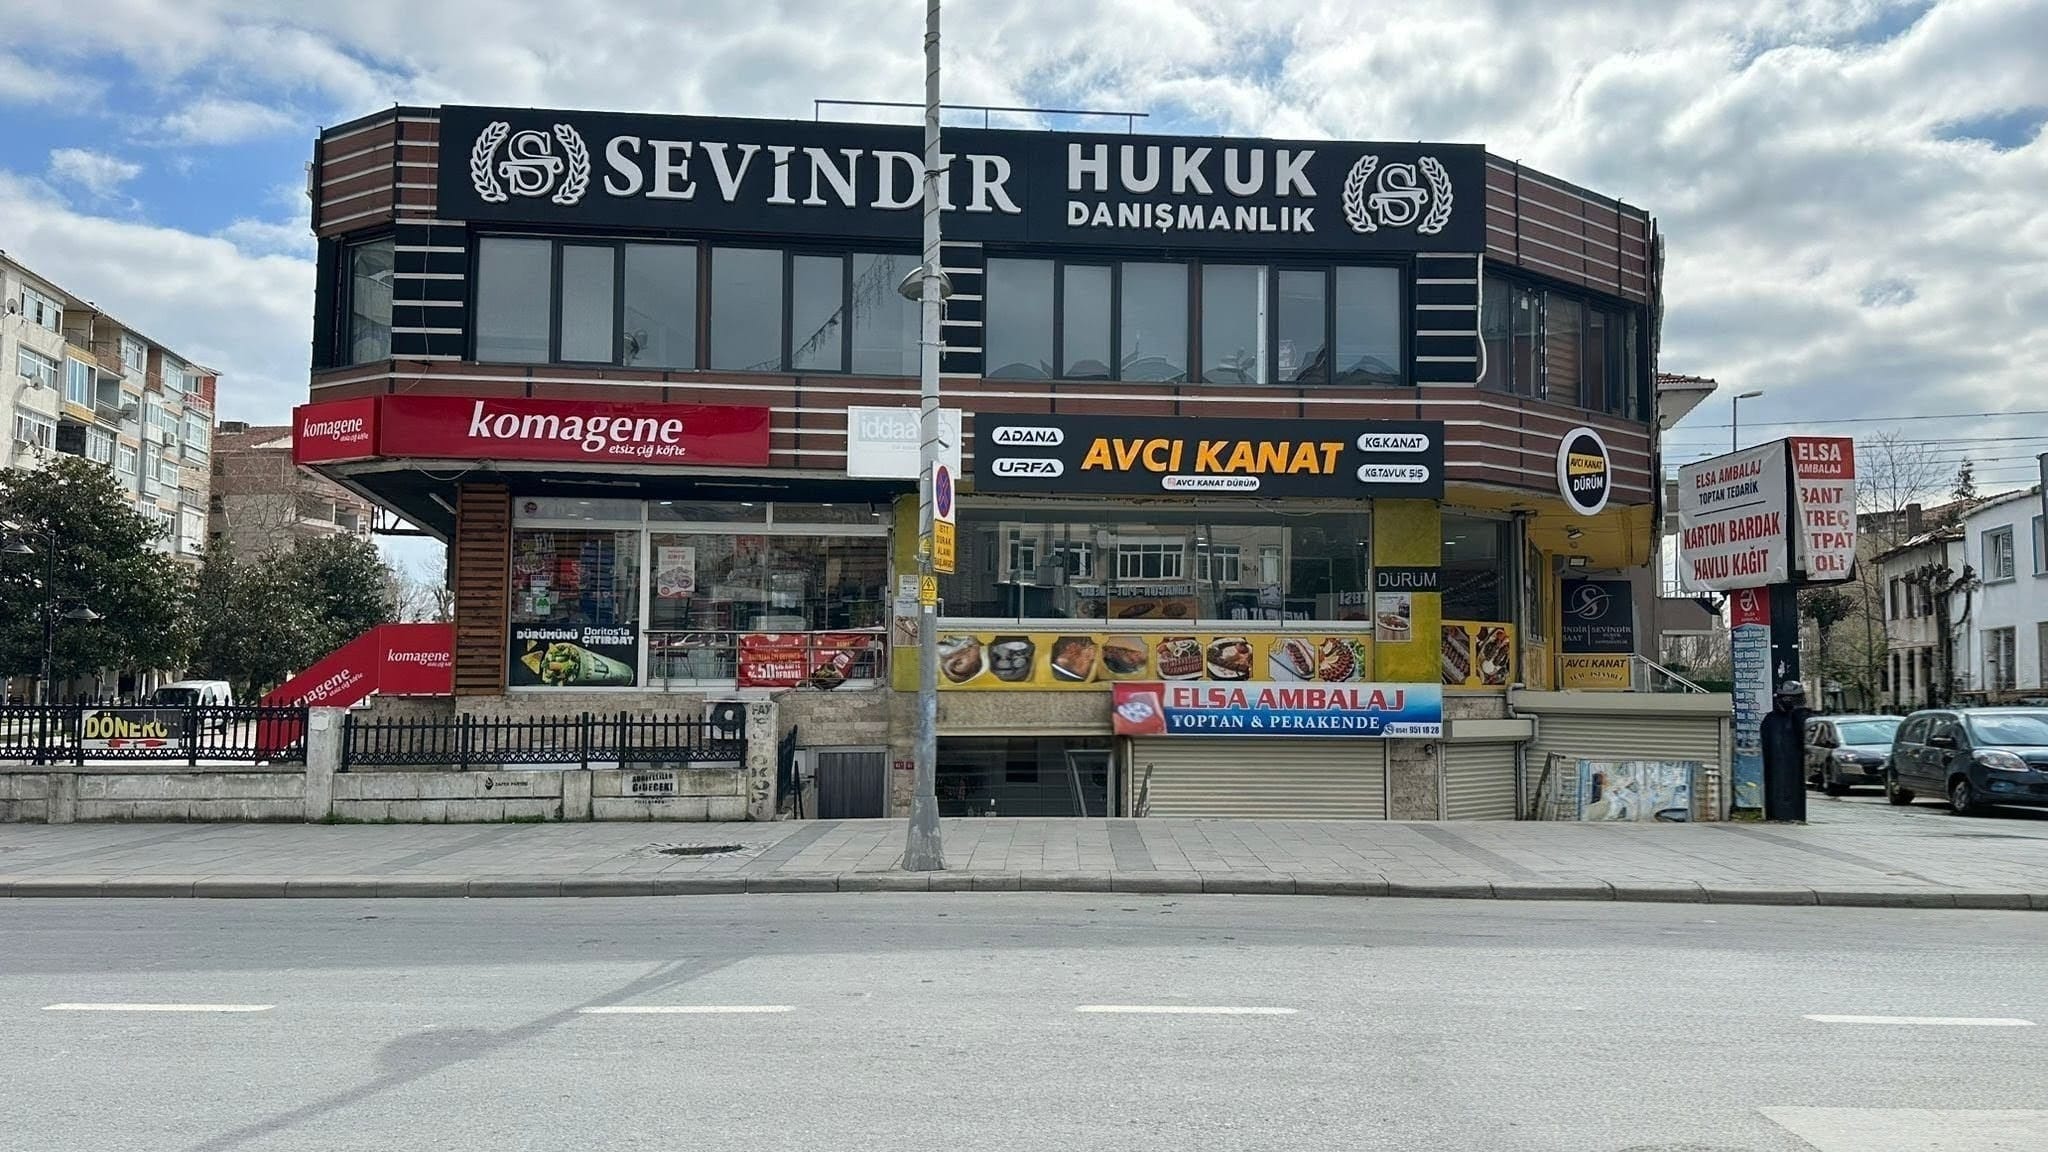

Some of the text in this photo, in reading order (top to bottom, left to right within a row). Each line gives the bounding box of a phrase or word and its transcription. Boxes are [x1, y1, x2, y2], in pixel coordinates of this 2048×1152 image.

[1068, 143, 1316, 198] HUKUK
[1068, 201, 1315, 234] DANIŞMANLIK
[303, 417, 363, 440] komagene
[468, 400, 683, 453] komagene
[998, 429, 1058, 443] ADANA
[1365, 437, 1423, 448] KG.KANAT
[608, 444, 635, 455] etsiz
[655, 444, 686, 457] köfte
[1081, 438, 1345, 475] AVCI KANAT
[1798, 443, 1842, 461] ELSA
[999, 462, 1057, 473] URFA
[1696, 459, 1761, 488] ELSA AMBALAJ
[1798, 463, 1842, 474] AMBALAJ
[1176, 478, 1257, 487] AVCI KANAT DÜRÜM
[1574, 474, 1603, 491] DÜRÜM
[1699, 489, 1725, 505] TOPTAN
[1684, 511, 1780, 550] KARTON BARDAK
[1694, 545, 1769, 580] HAVLU KAĞIT
[516, 628, 578, 640] DÜRÜMÜNÜ
[584, 626, 630, 636] Doritos'la
[387, 649, 449, 666] komagene
[1566, 659, 1626, 668] AVCI KANAT
[1173, 687, 1405, 711] ELSA AMBALAJ
[1172, 714, 1380, 730] TOPTAN & PERAKENDE
